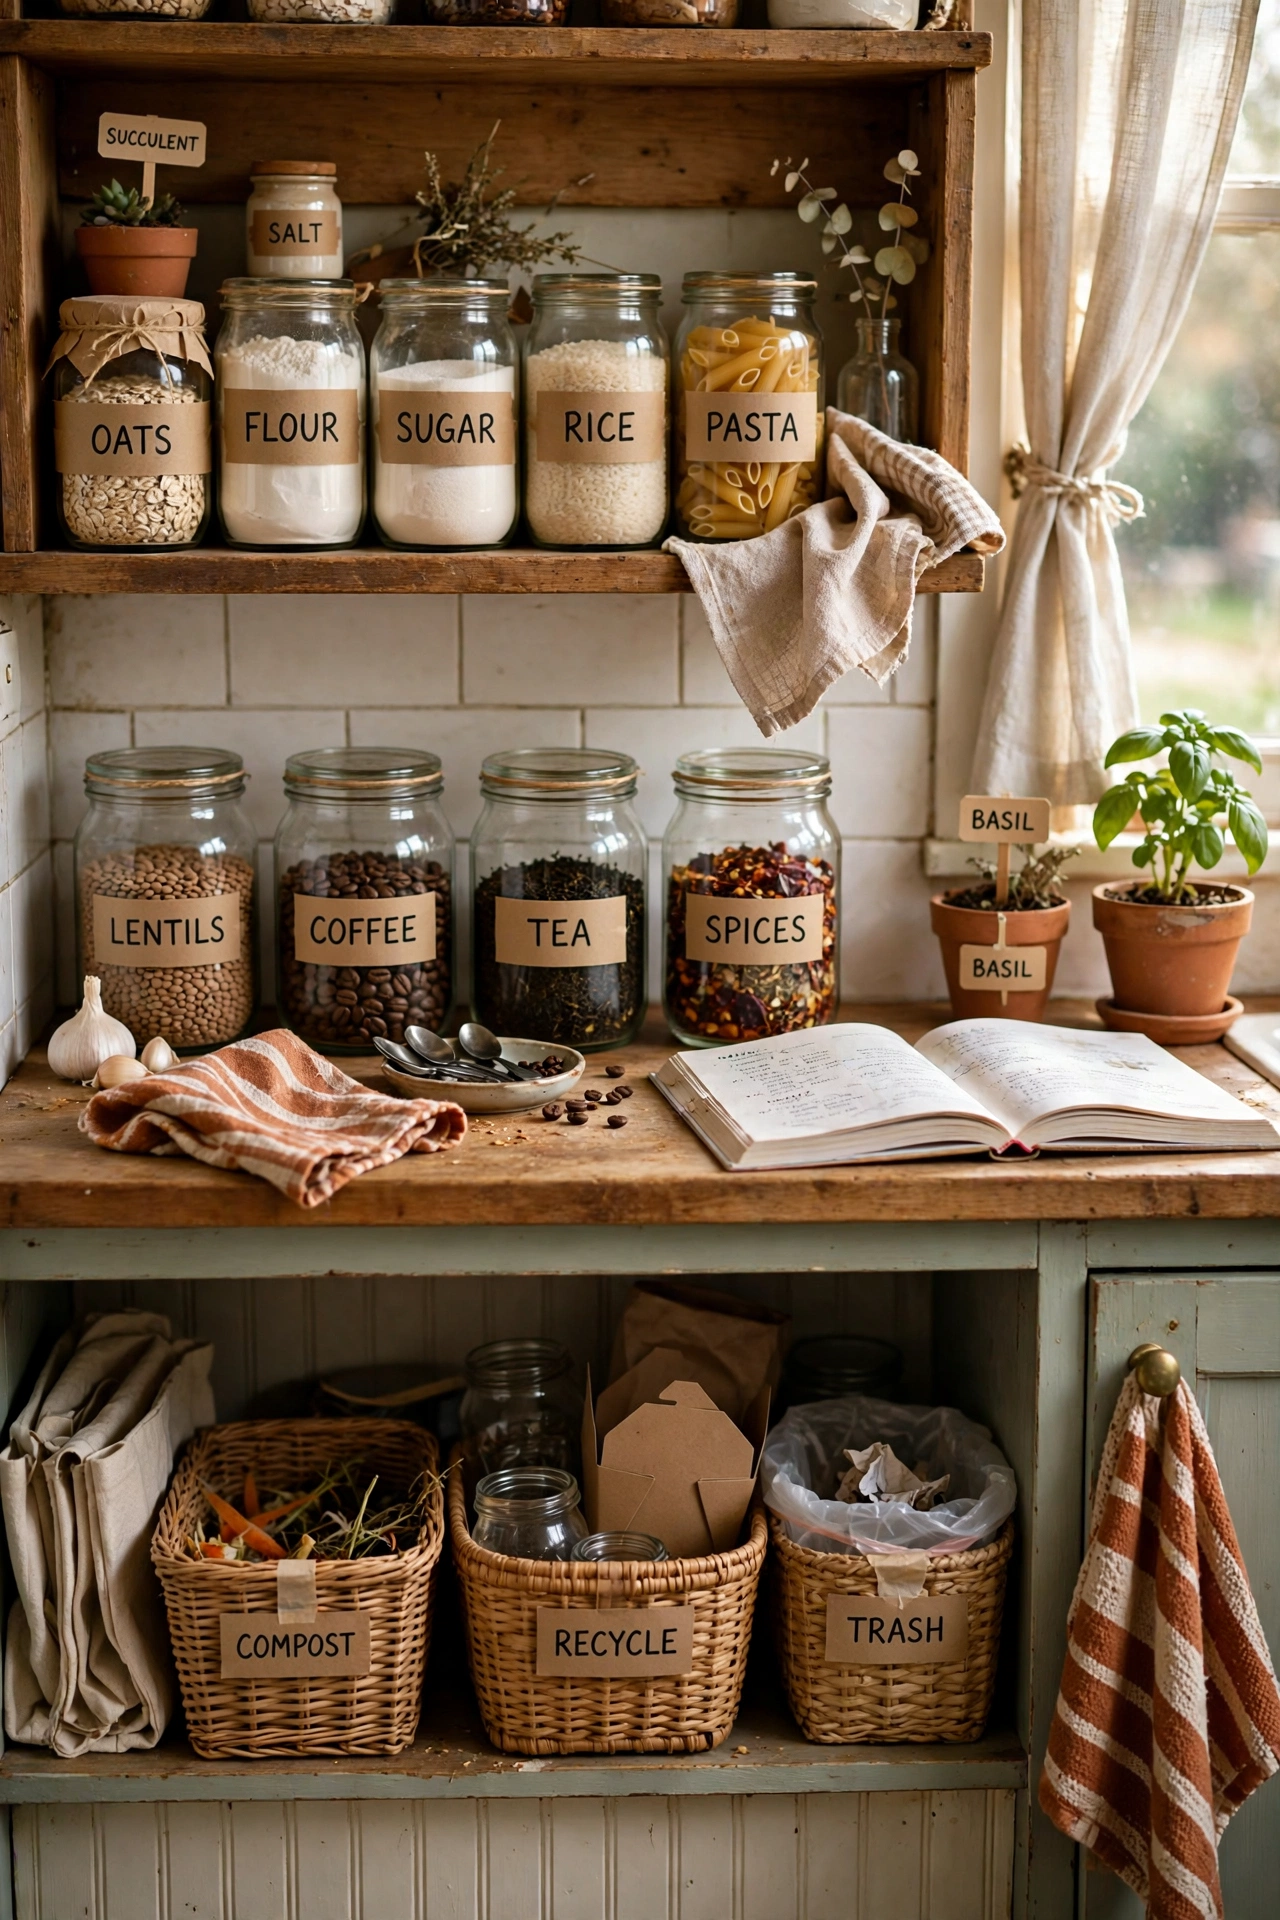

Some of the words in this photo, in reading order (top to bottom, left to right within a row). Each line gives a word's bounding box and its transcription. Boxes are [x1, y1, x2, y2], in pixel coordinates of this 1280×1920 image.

[106, 127, 199, 152] SUCCULENT
[268, 222, 323, 244] SALT
[91, 424, 172, 456] OATS
[245, 411, 339, 443] FLOUR
[397, 411, 496, 444] SUGAR
[564, 410, 635, 443] RICE
[706, 411, 798, 443] PASTA
[972, 810, 1035, 831] BASIL
[110, 916, 225, 946] LENTILS
[309, 915, 417, 945] COFFEE
[527, 918, 591, 947] TEA
[705, 915, 806, 945] SPICES
[972, 958, 1033, 978] BASIL
[555, 1628, 678, 1657] RECYCLE
[847, 1616, 944, 1644] TRASH
[236, 1632, 356, 1659] COMPOST
